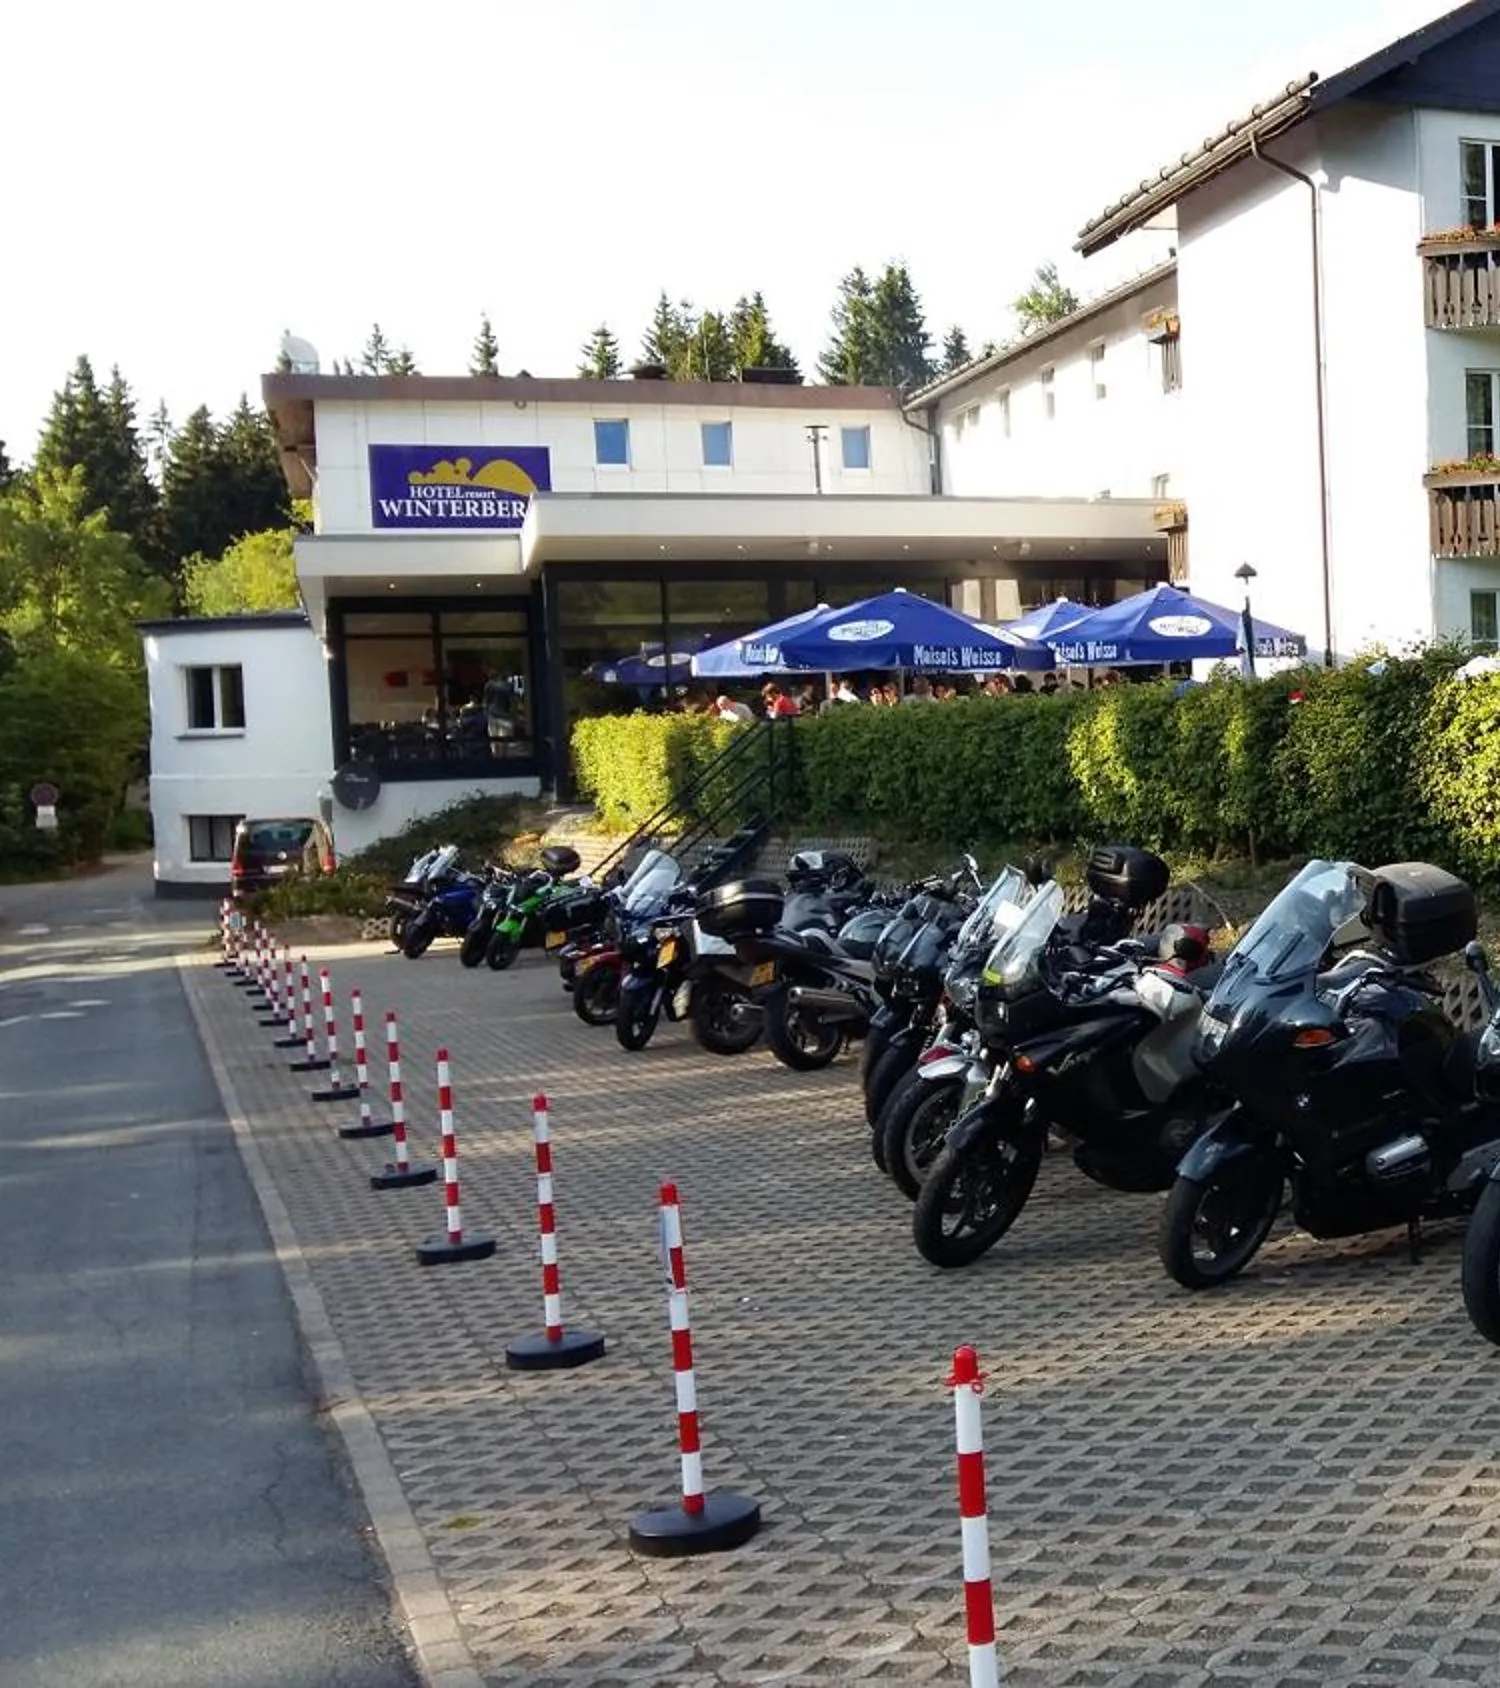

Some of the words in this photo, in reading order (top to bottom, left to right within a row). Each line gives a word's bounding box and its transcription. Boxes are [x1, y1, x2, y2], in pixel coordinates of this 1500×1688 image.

[409, 485, 464, 499] HOTEL
[465, 489, 497, 499] resort
[380, 499, 530, 518] WINTERBER
[913, 644, 958, 666] Maisel's
[961, 645, 1001, 667] Weisse
